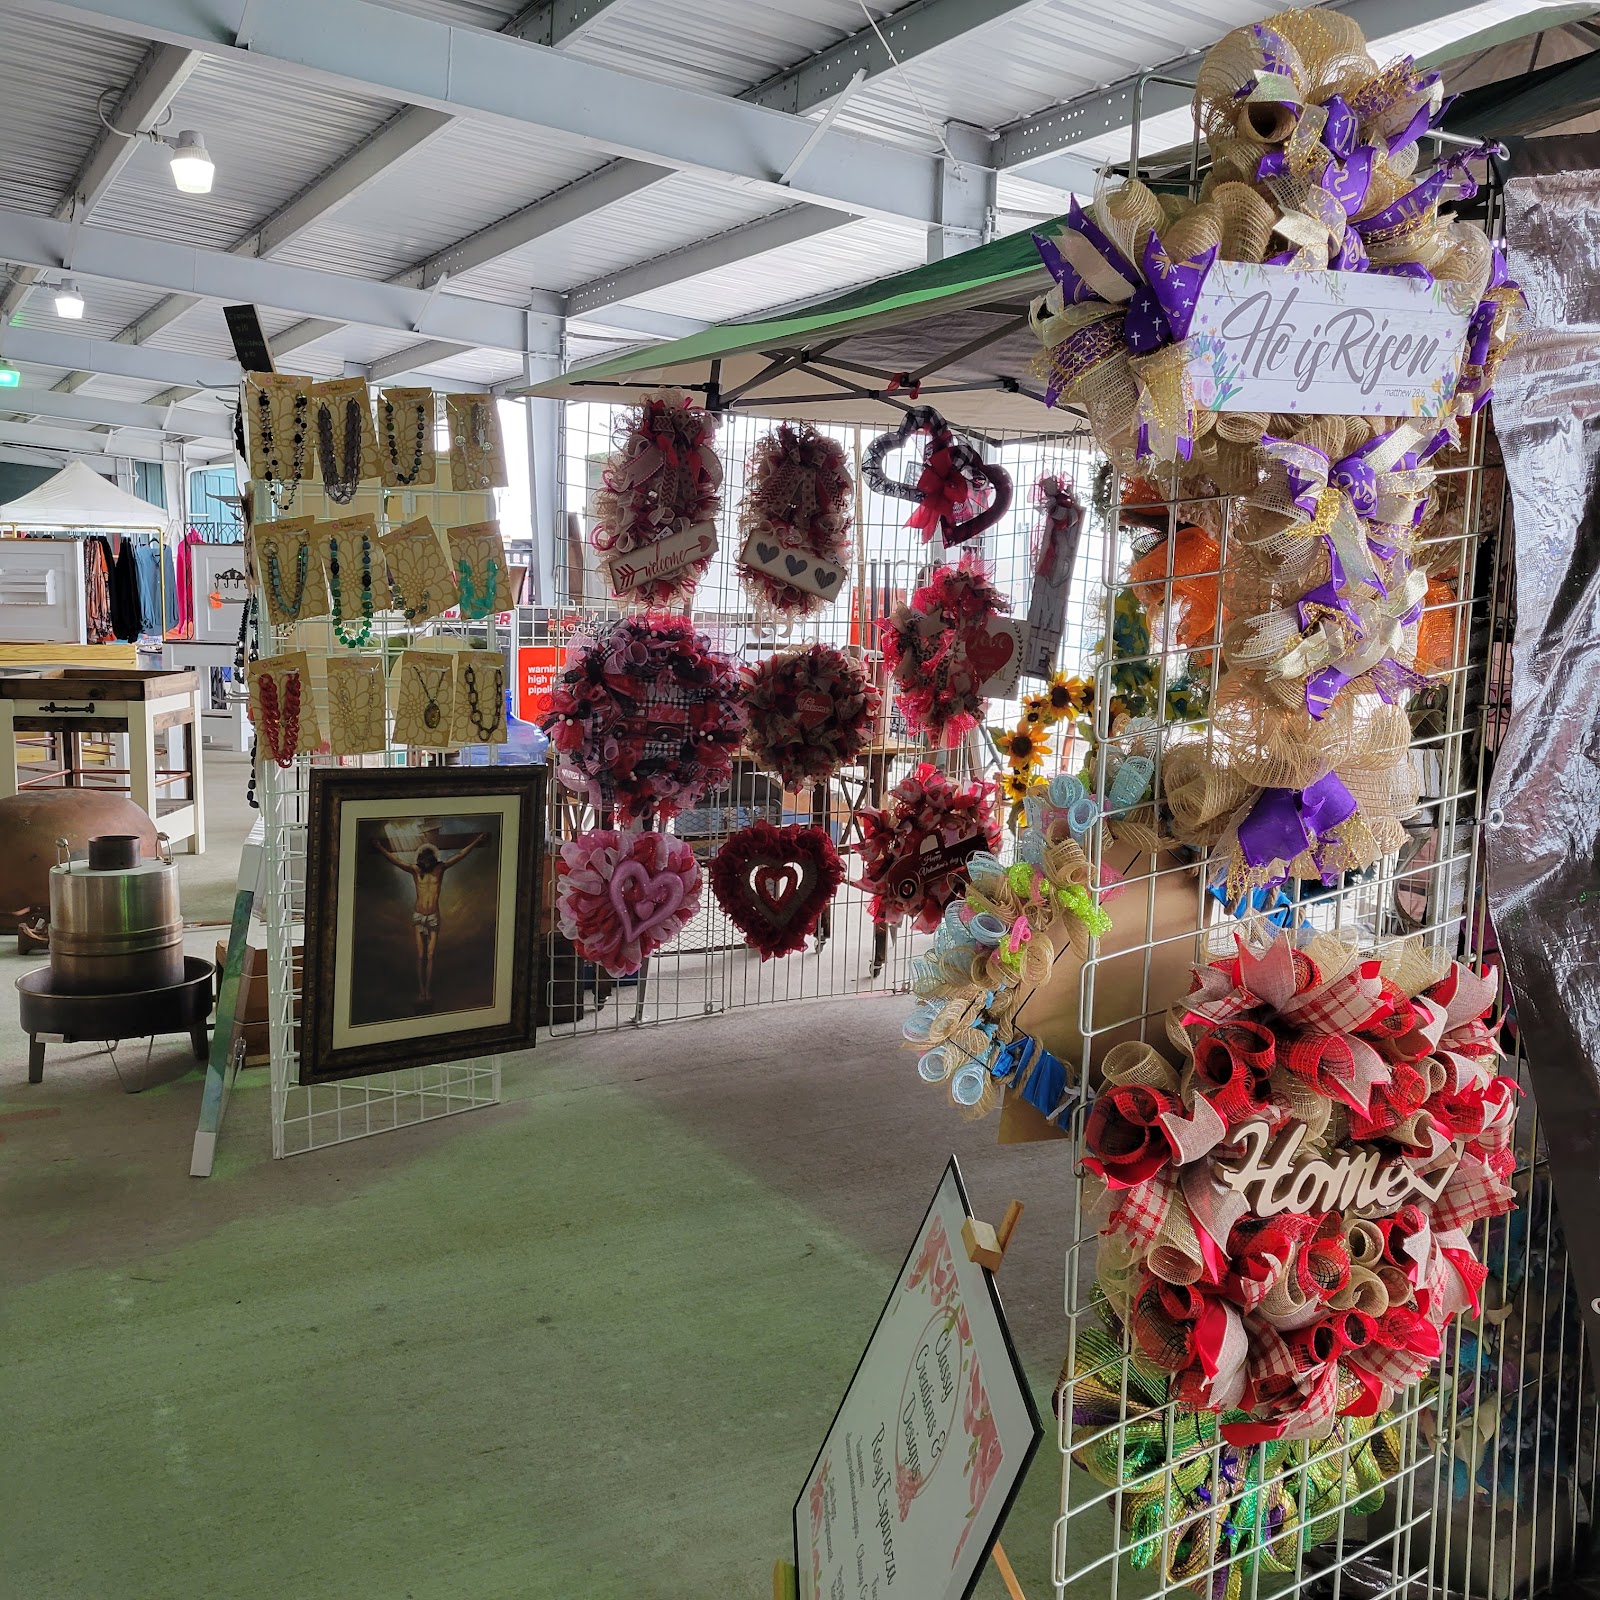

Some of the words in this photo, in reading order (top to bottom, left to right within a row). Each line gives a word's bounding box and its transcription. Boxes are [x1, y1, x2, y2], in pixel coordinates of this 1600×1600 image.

[1221, 287, 1297, 378] He
[1293, 324, 1331, 393] is
[1324, 308, 1440, 396] Risen
[1384, 388, 1411, 398] matthew
[645, 541, 687, 578] welcome
[527, 675, 548, 685] high
[921, 853, 942, 866] Happy
[1223, 1121, 1417, 1217] Home
[916, 1344, 937, 1438] Creations
[931, 1430, 946, 1458] &
[936, 1328, 953, 1403] Classy
[871, 1422, 885, 1489] Rosy
[903, 1392, 921, 1482] Designs
[875, 1471, 897, 1586] Espinoza
